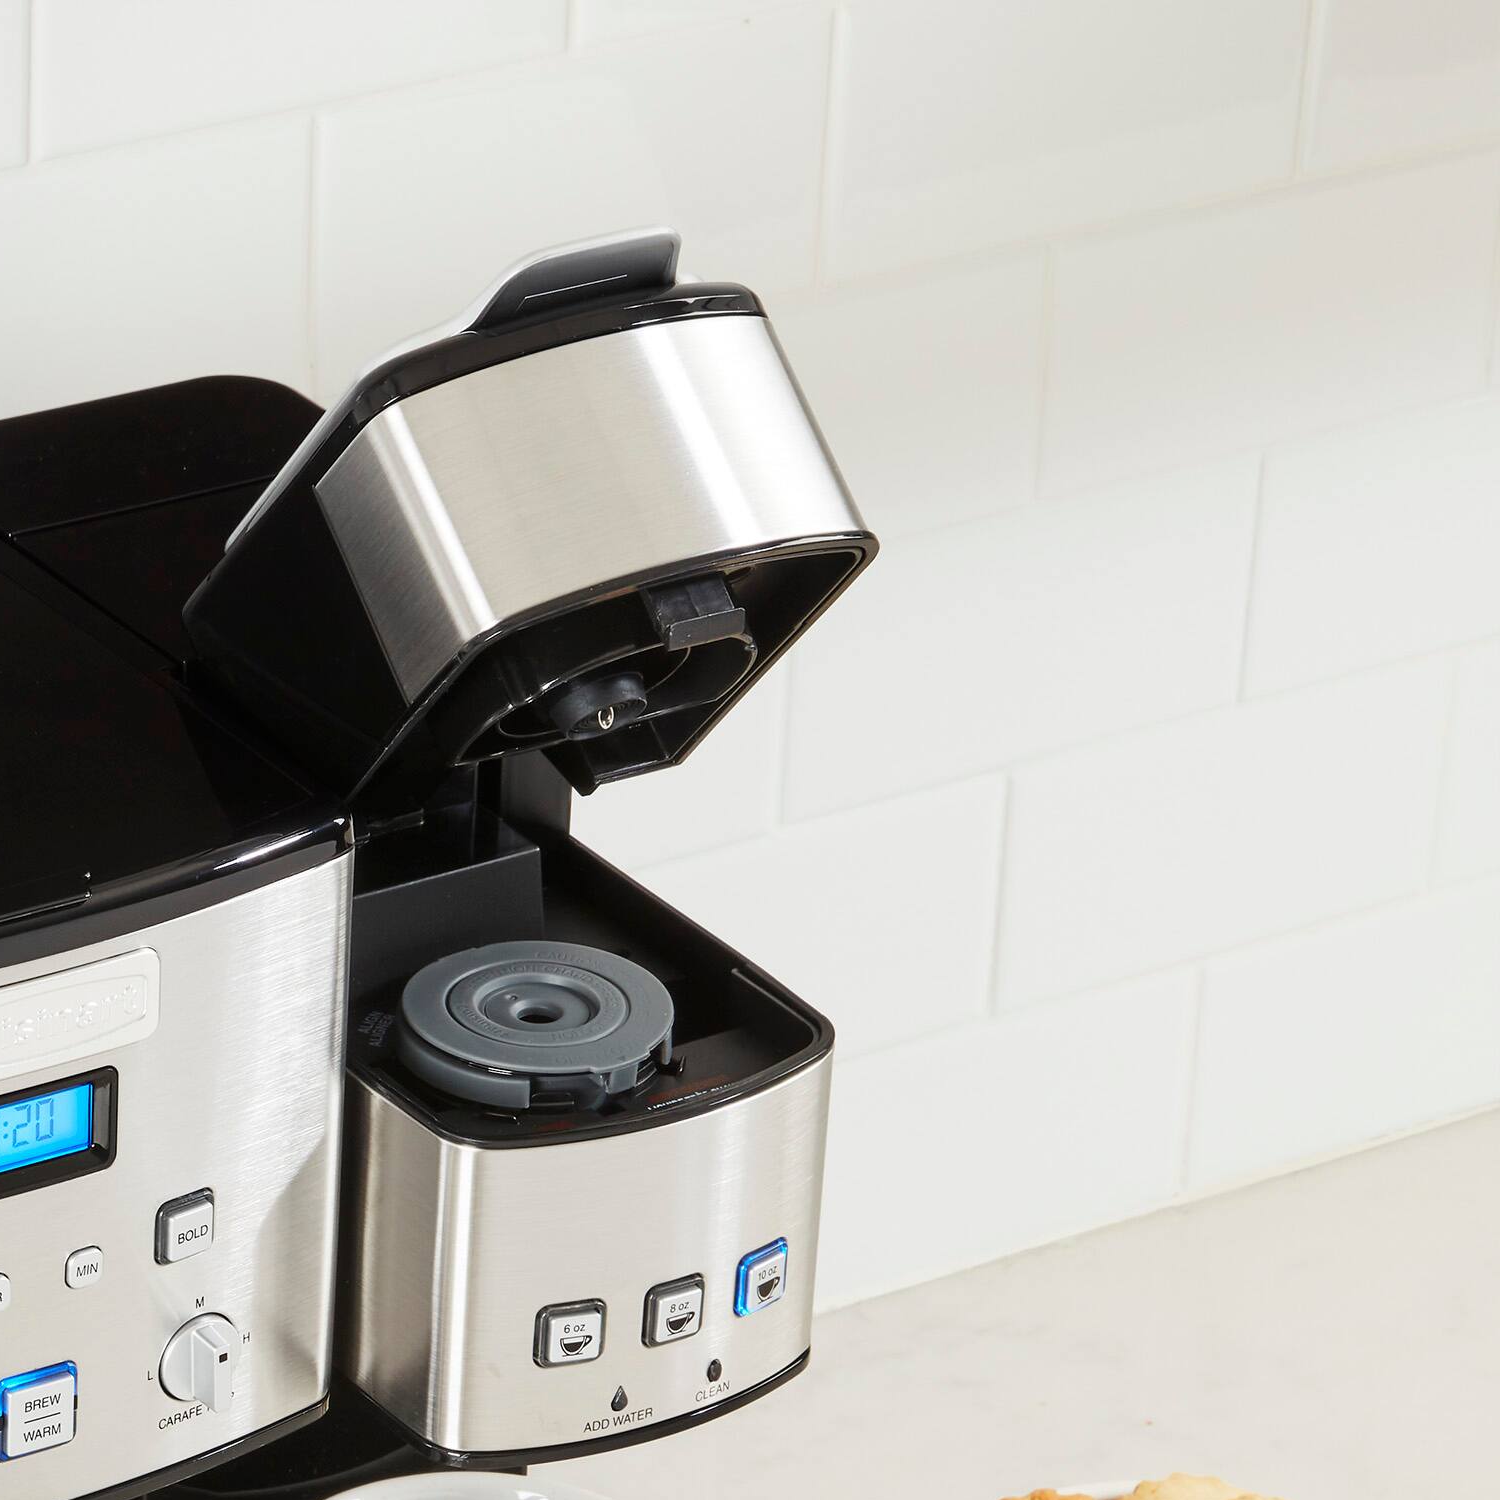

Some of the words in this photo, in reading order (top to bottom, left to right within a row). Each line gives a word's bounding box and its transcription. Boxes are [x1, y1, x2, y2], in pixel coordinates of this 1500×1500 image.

[177, 1224, 209, 1245] BOLD
[76, 1262, 99, 1277] MIN
[758, 1269, 767, 1281] 10
[768, 1265, 778, 1277] oz
[195, 1296, 205, 1309] M
[669, 1303, 677, 1314] 8
[678, 1301, 690, 1312] oz
[563, 1324, 571, 1334] 6
[573, 1324, 586, 1333] oz
[242, 1332, 251, 1345] H
[147, 1370, 154, 1381] L
[695, 1380, 730, 1402] CLEAN
[24, 1392, 61, 1413] BREW
[158, 1404, 203, 1430] CARAFE
[583, 1418, 610, 1433] ADD
[612, 1407, 654, 1427] WATER
[23, 1422, 62, 1443] WARM
